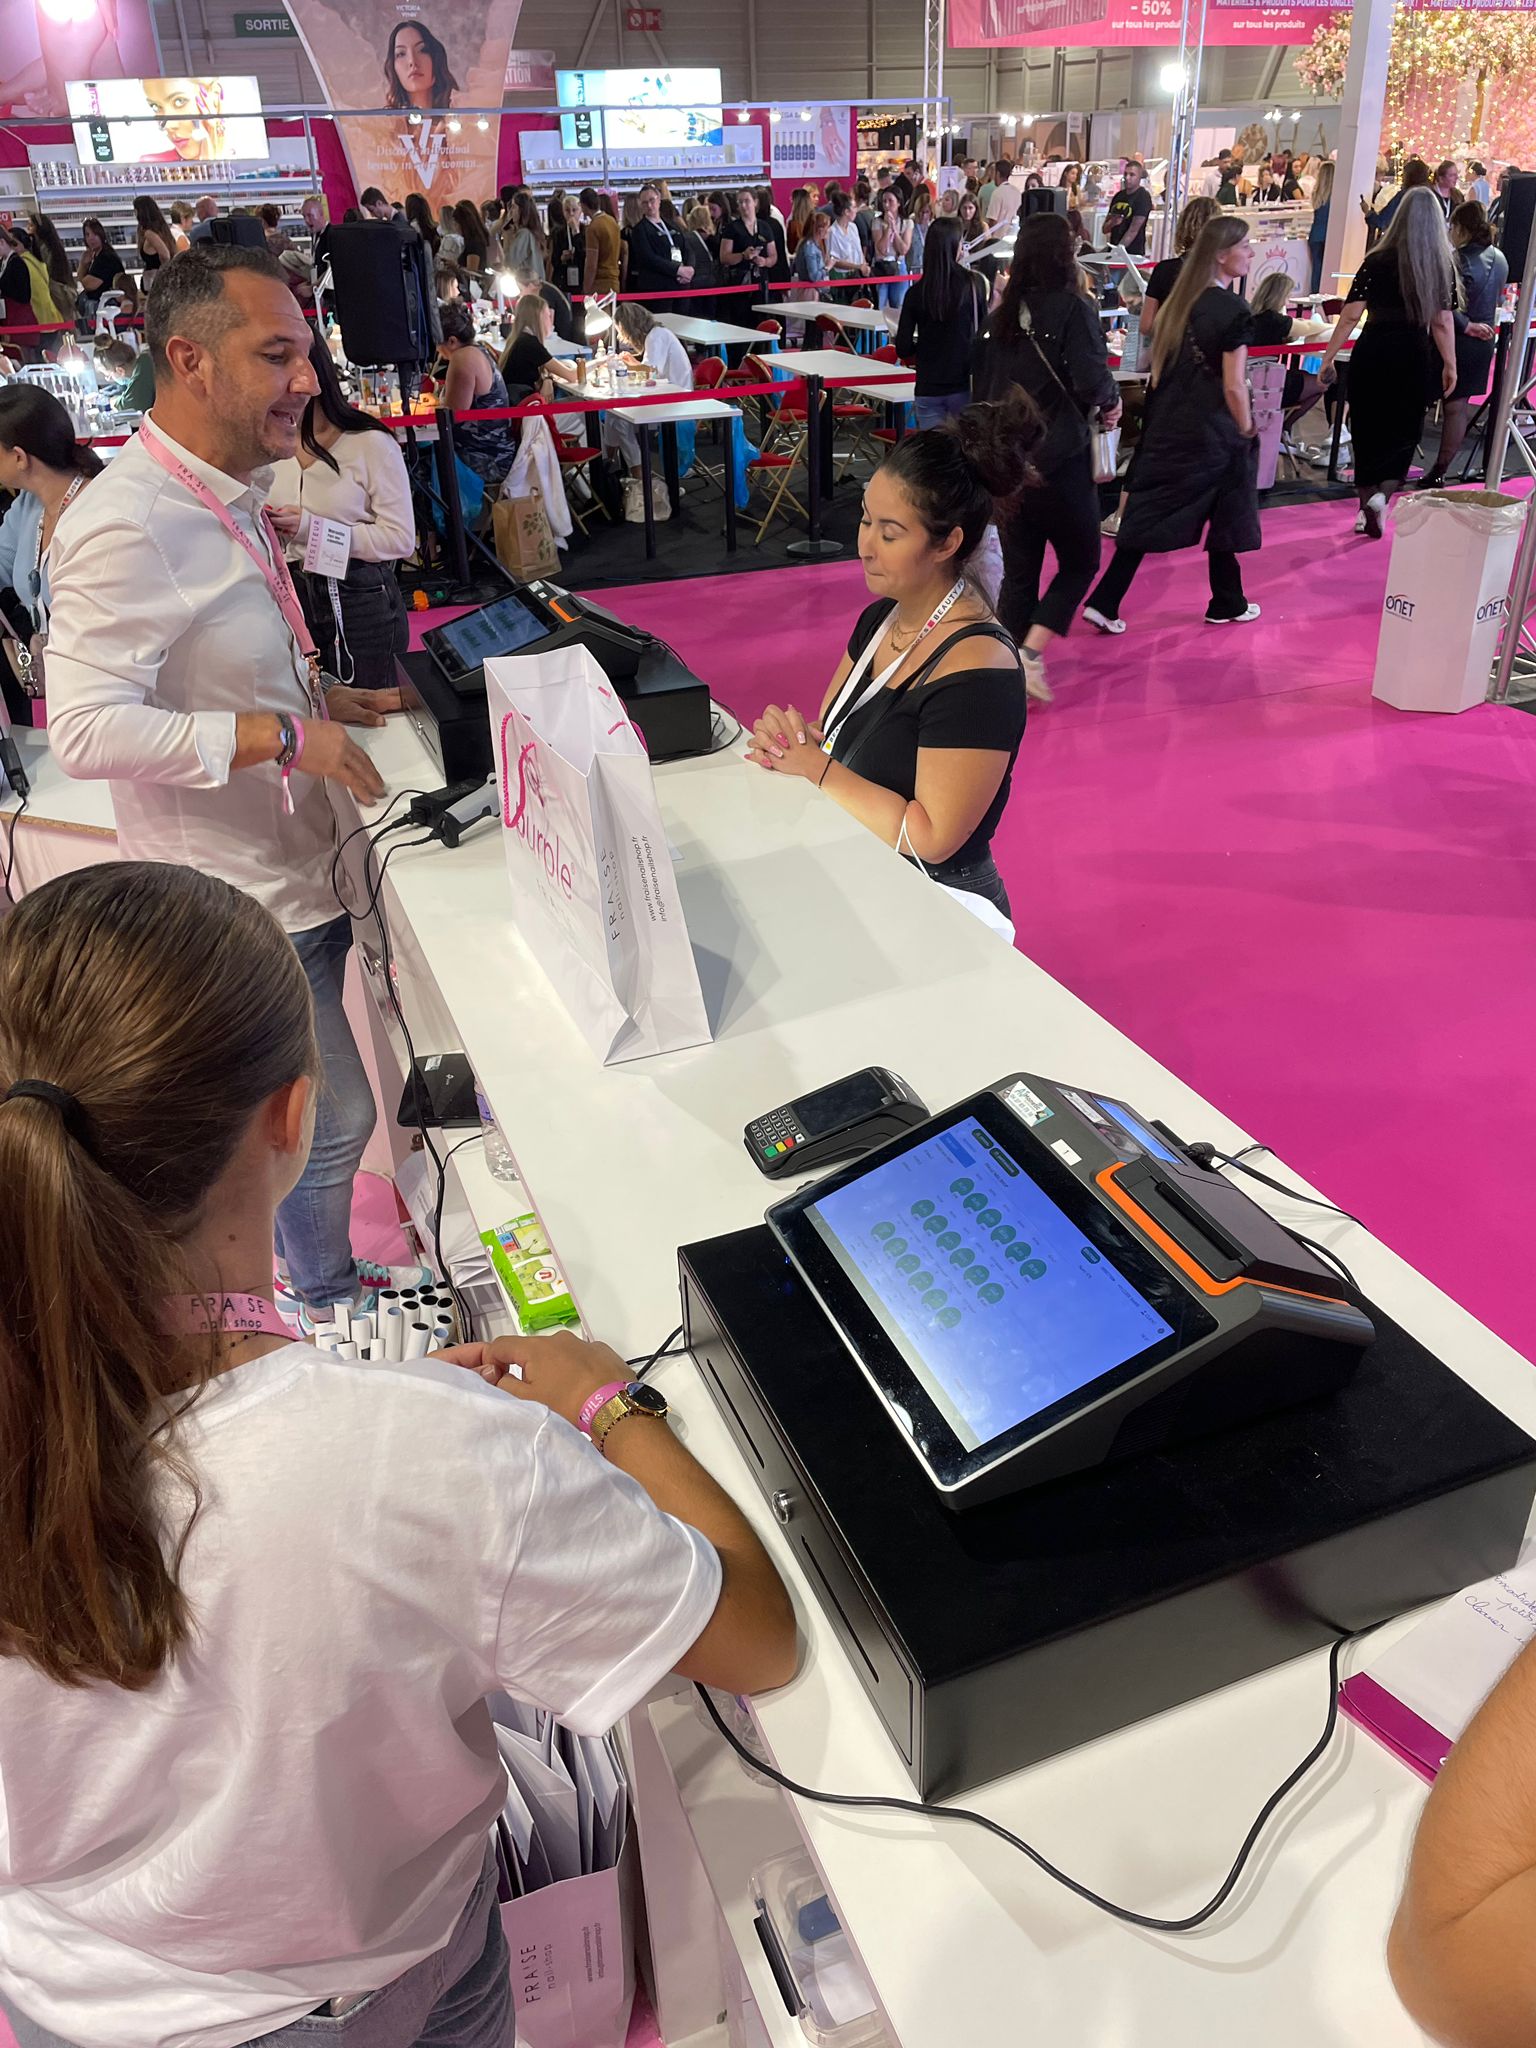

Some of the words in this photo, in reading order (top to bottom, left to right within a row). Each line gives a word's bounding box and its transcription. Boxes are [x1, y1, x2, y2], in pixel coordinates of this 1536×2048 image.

[1142, 0, 1172, 15] 50%
[245, 19, 290, 31] SORTIE
[308, 520, 320, 565] VISITEUR
[933, 589, 959, 620] BEAUTY
[601, 848, 620, 940] FRAISE
[632, 836, 657, 922] www.fraisenailshop.fr
[641, 835, 667, 922] info@fraisenailshop.fr
[191, 1297, 265, 1315] FRAISE
[234, 1317, 262, 1330] shop
[581, 1394, 604, 1424] NAILS
[520, 1945, 541, 2003] FRAISE
